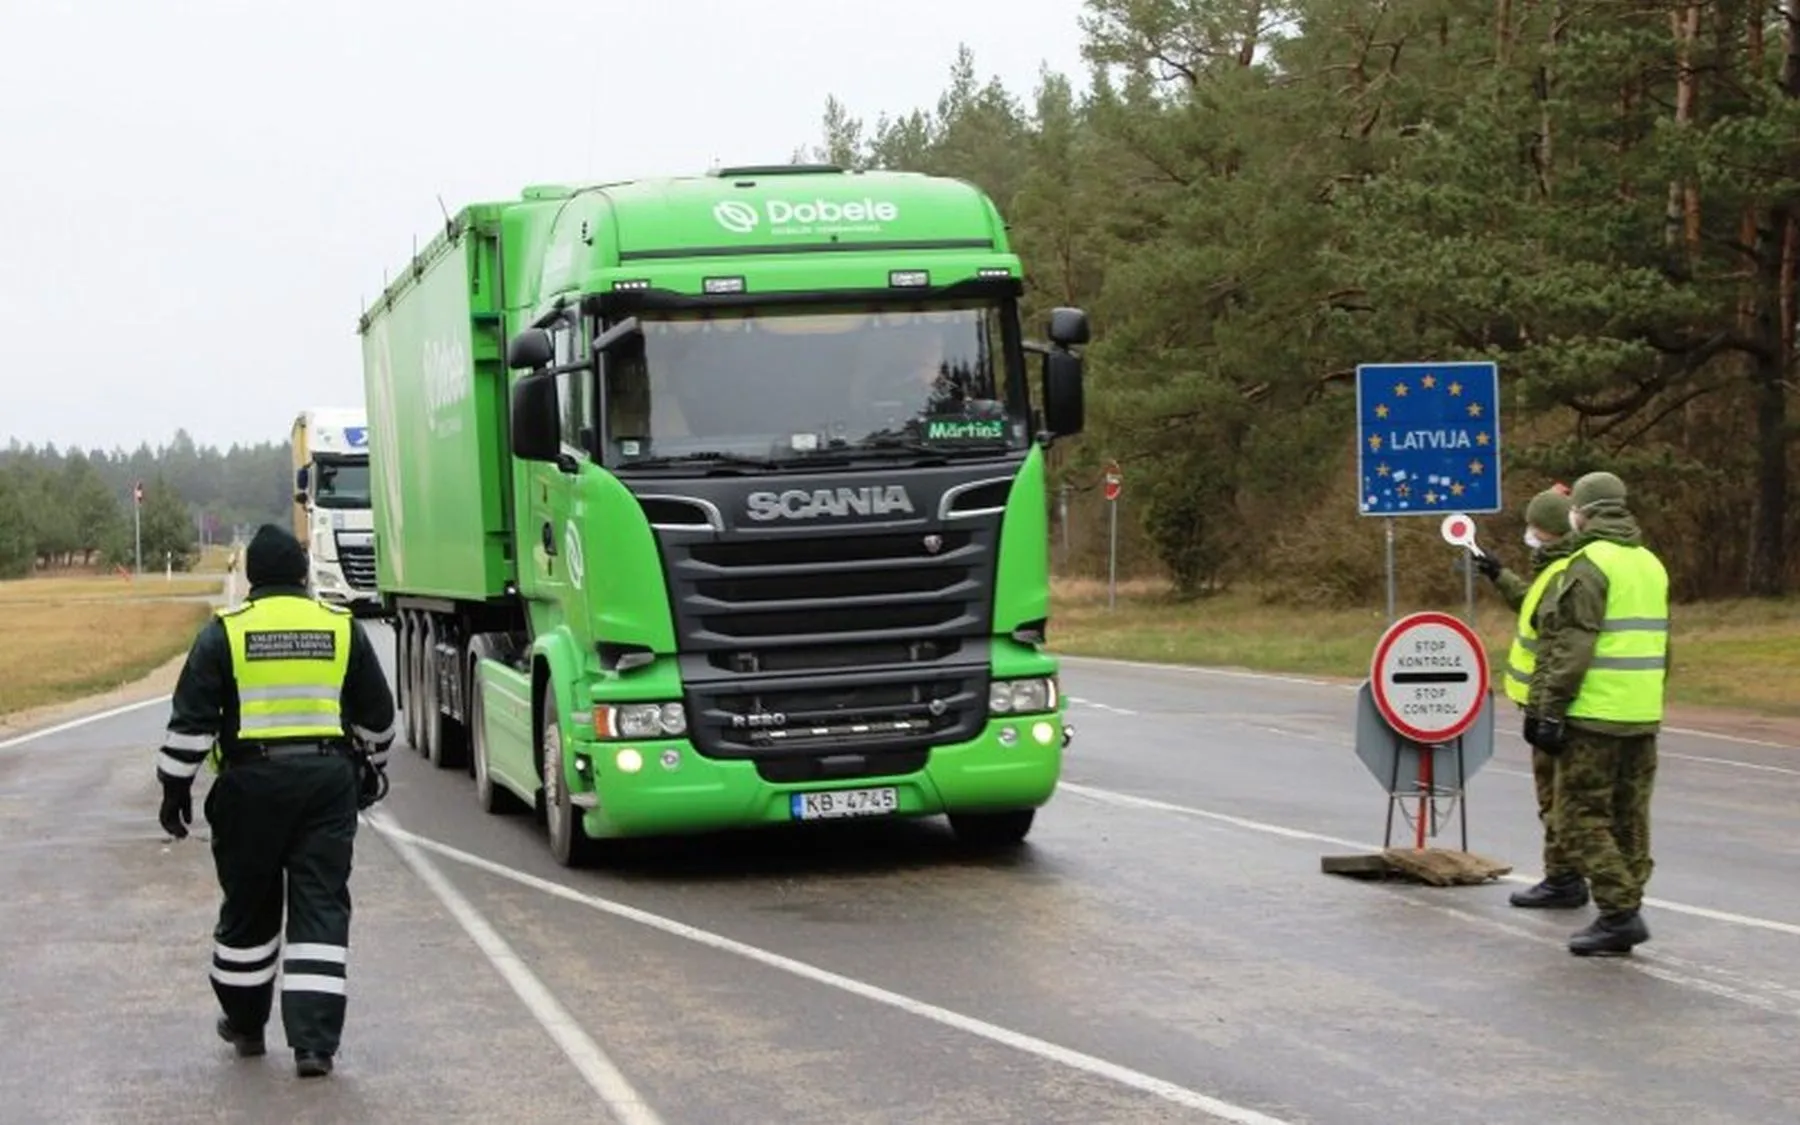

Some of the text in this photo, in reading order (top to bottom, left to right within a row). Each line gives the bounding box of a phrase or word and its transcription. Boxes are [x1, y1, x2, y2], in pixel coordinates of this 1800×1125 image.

[766, 197, 899, 224] Dobele
[1390, 428, 1472, 450] LATVIJA
[746, 485, 915, 521] SCANIA
[1415, 640, 1447, 653] STOP
[1398, 655, 1463, 668] KONTROLE
[1414, 687, 1447, 700] STOP
[1403, 703, 1460, 715] CONTROL
[732, 714, 746, 728] R
